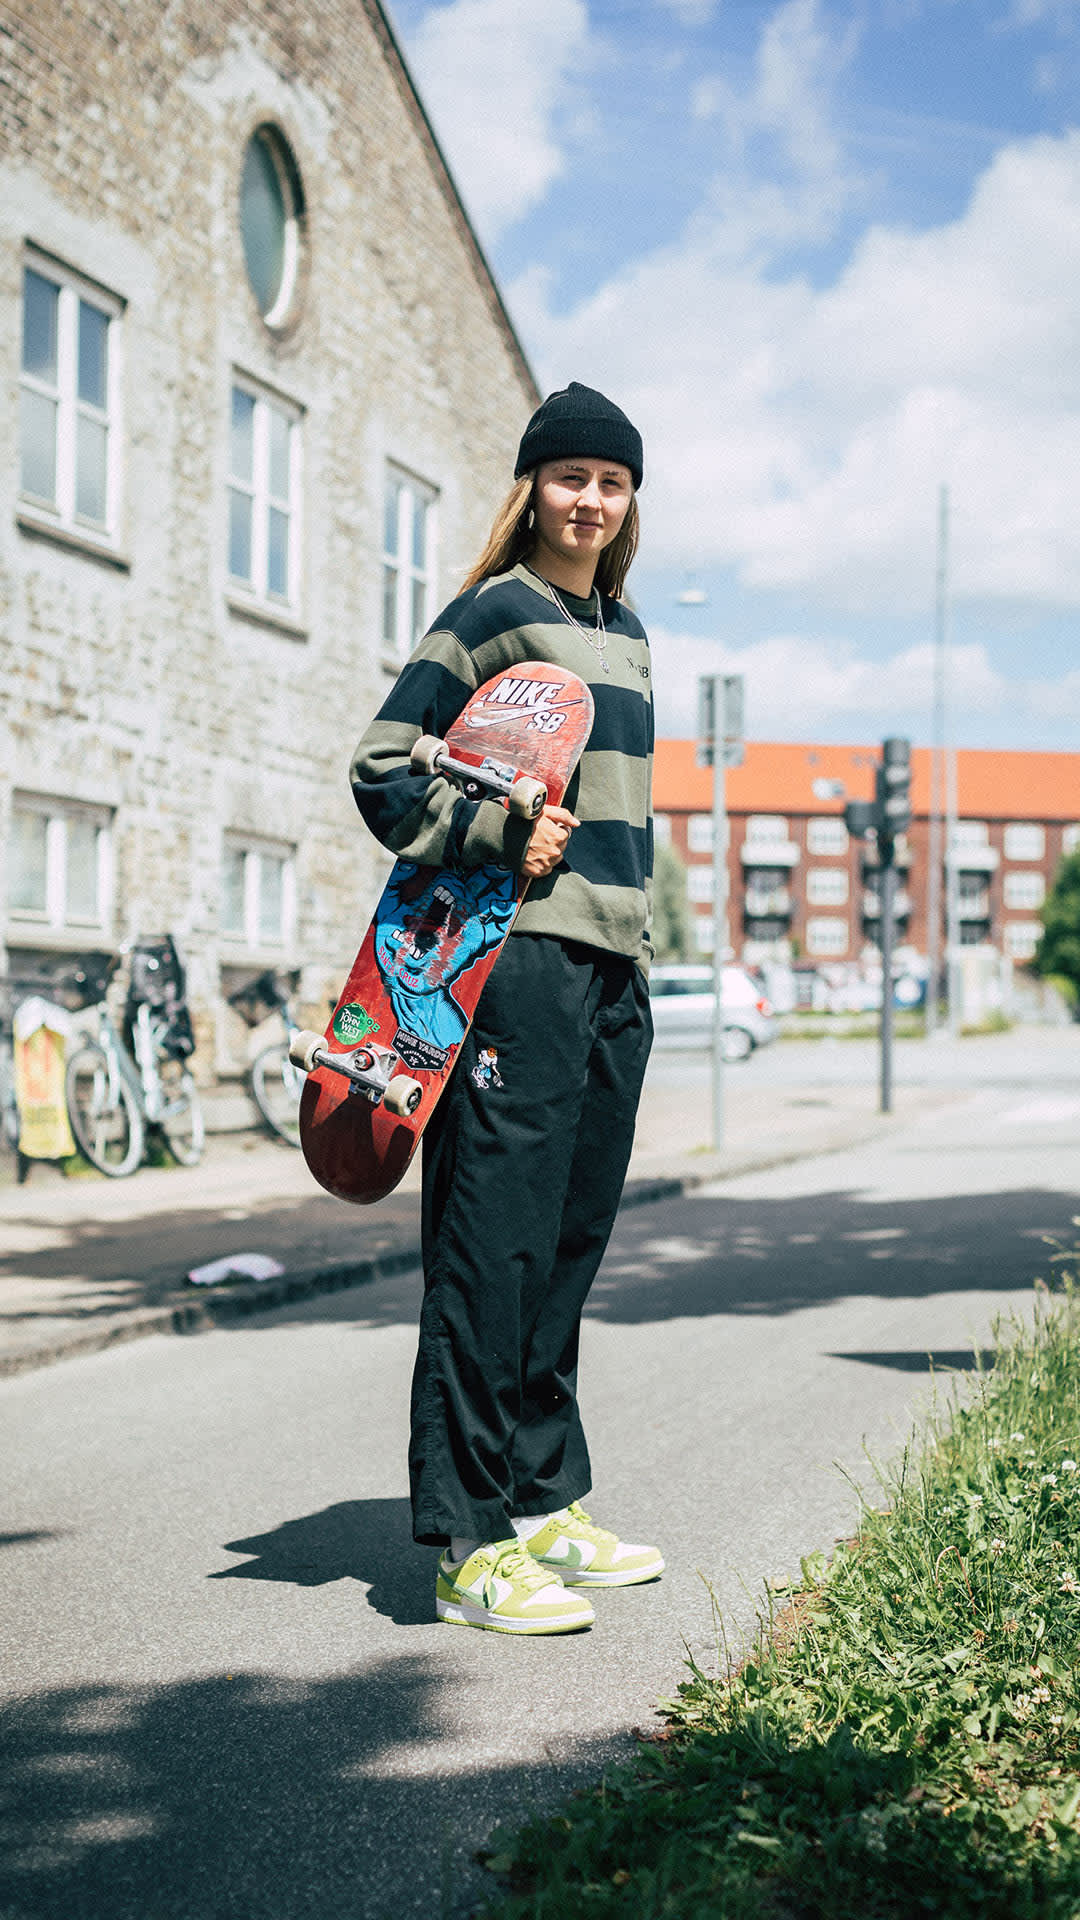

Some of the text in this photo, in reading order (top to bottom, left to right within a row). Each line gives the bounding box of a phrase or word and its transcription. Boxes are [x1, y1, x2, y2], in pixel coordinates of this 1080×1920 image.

[487, 677, 565, 705] NIKE
[525, 710, 567, 734] SB
[377, 945, 419, 988] SANTA CRUZ
[340, 1008, 361, 1028] JOHN
[341, 1021, 361, 1038] WEST
[419, 1041, 446, 1062] YARDS
